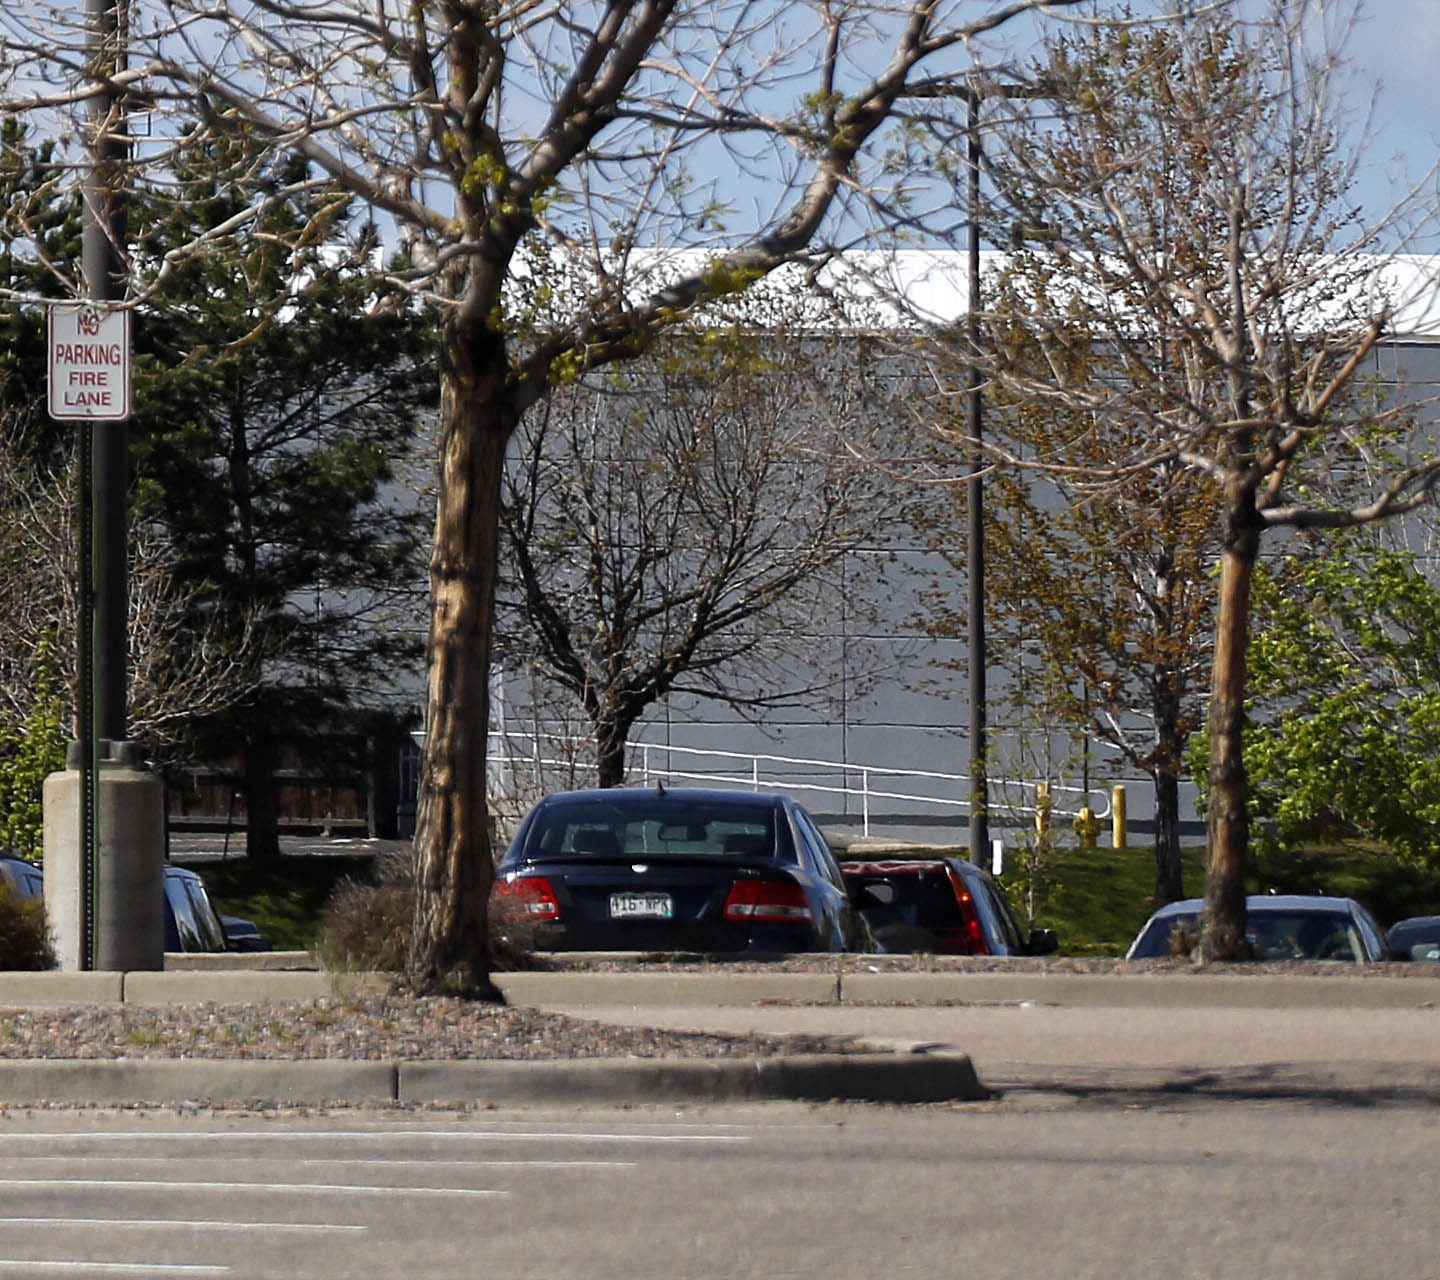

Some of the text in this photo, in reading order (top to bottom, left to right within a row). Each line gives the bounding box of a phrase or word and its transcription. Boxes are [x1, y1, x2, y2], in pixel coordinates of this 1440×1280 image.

[76, 312, 100, 336] NO
[55, 344, 121, 366] PARKING
[69, 372, 108, 386] FIRE
[64, 392, 112, 406] LANE
